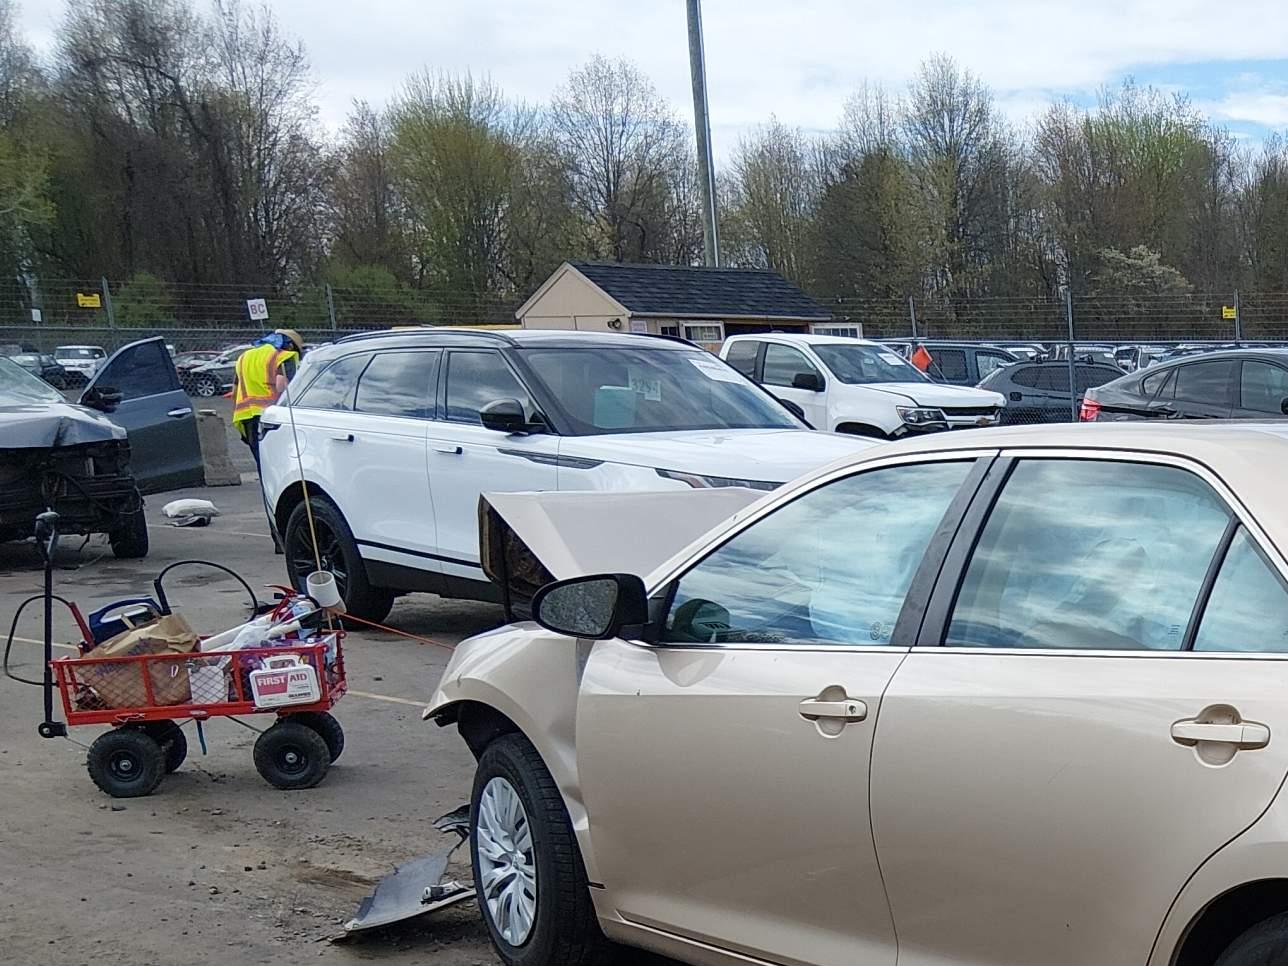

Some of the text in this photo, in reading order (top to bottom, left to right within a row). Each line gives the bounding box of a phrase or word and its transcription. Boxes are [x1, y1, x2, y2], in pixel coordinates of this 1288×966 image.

[250, 303, 266, 315] BC
[257, 675, 286, 687] FIRST
[290, 673, 308, 682] AID
